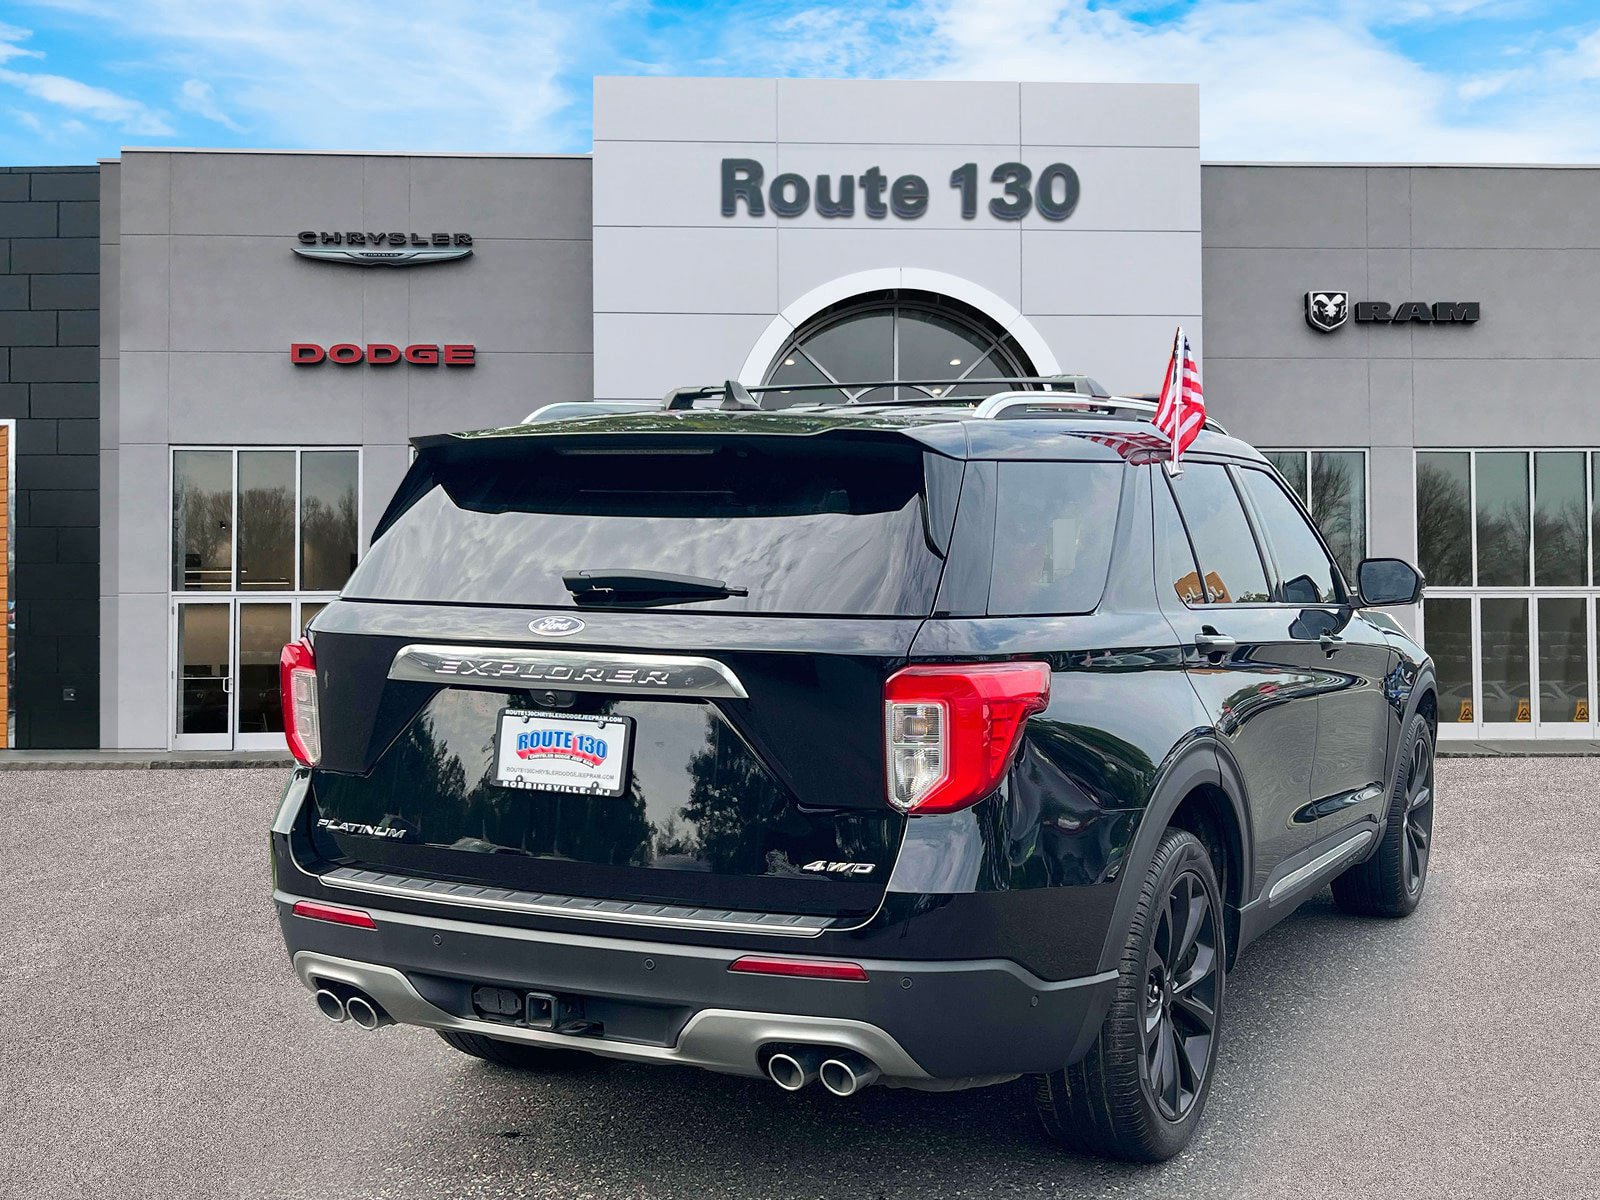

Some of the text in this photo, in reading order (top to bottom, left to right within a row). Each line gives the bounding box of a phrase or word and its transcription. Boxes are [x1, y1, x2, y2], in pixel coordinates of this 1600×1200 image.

[721, 158, 1081, 221] Route 130
[298, 231, 473, 245] CHRYSLER
[1354, 302, 1480, 324] RAM
[291, 343, 476, 366] DODGE
[538, 619, 572, 631] Ford
[434, 658, 669, 685] EXPLORER
[518, 731, 607, 758] ROUTE 130
[502, 780, 591, 795] ROBBINSVILLE,
[317, 818, 407, 838] PLATINUM
[802, 860, 876, 874] 4WD
